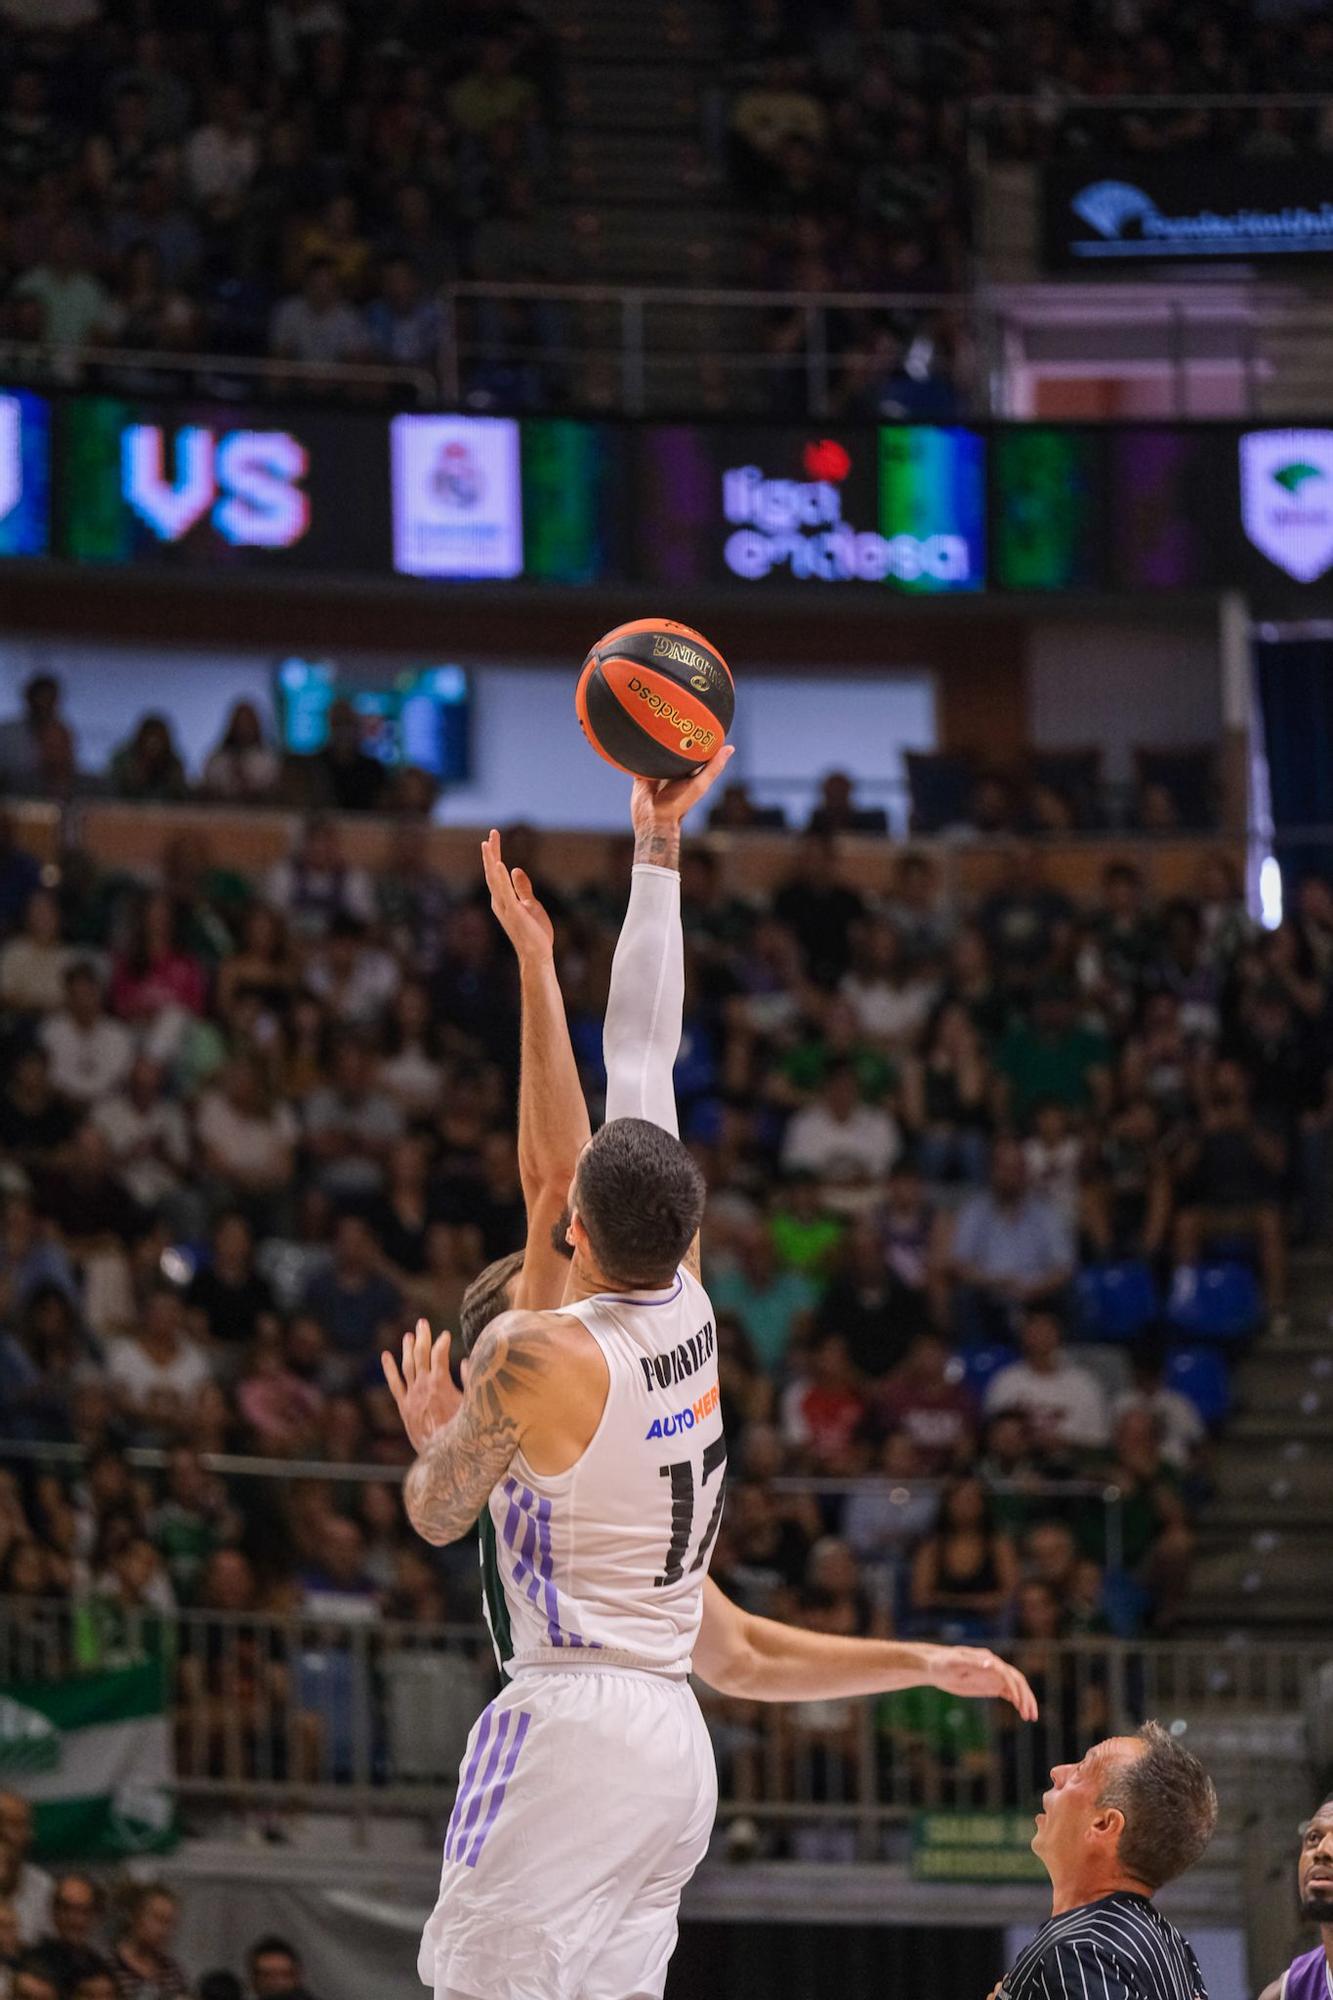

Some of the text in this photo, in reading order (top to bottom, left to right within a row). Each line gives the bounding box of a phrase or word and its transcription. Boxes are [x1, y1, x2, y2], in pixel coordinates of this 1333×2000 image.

[121, 423, 311, 547] VS
[639, 1321, 713, 1392] POIRIER
[645, 1381, 720, 1440] AUTOHER
[653, 1435, 727, 1587] 17
